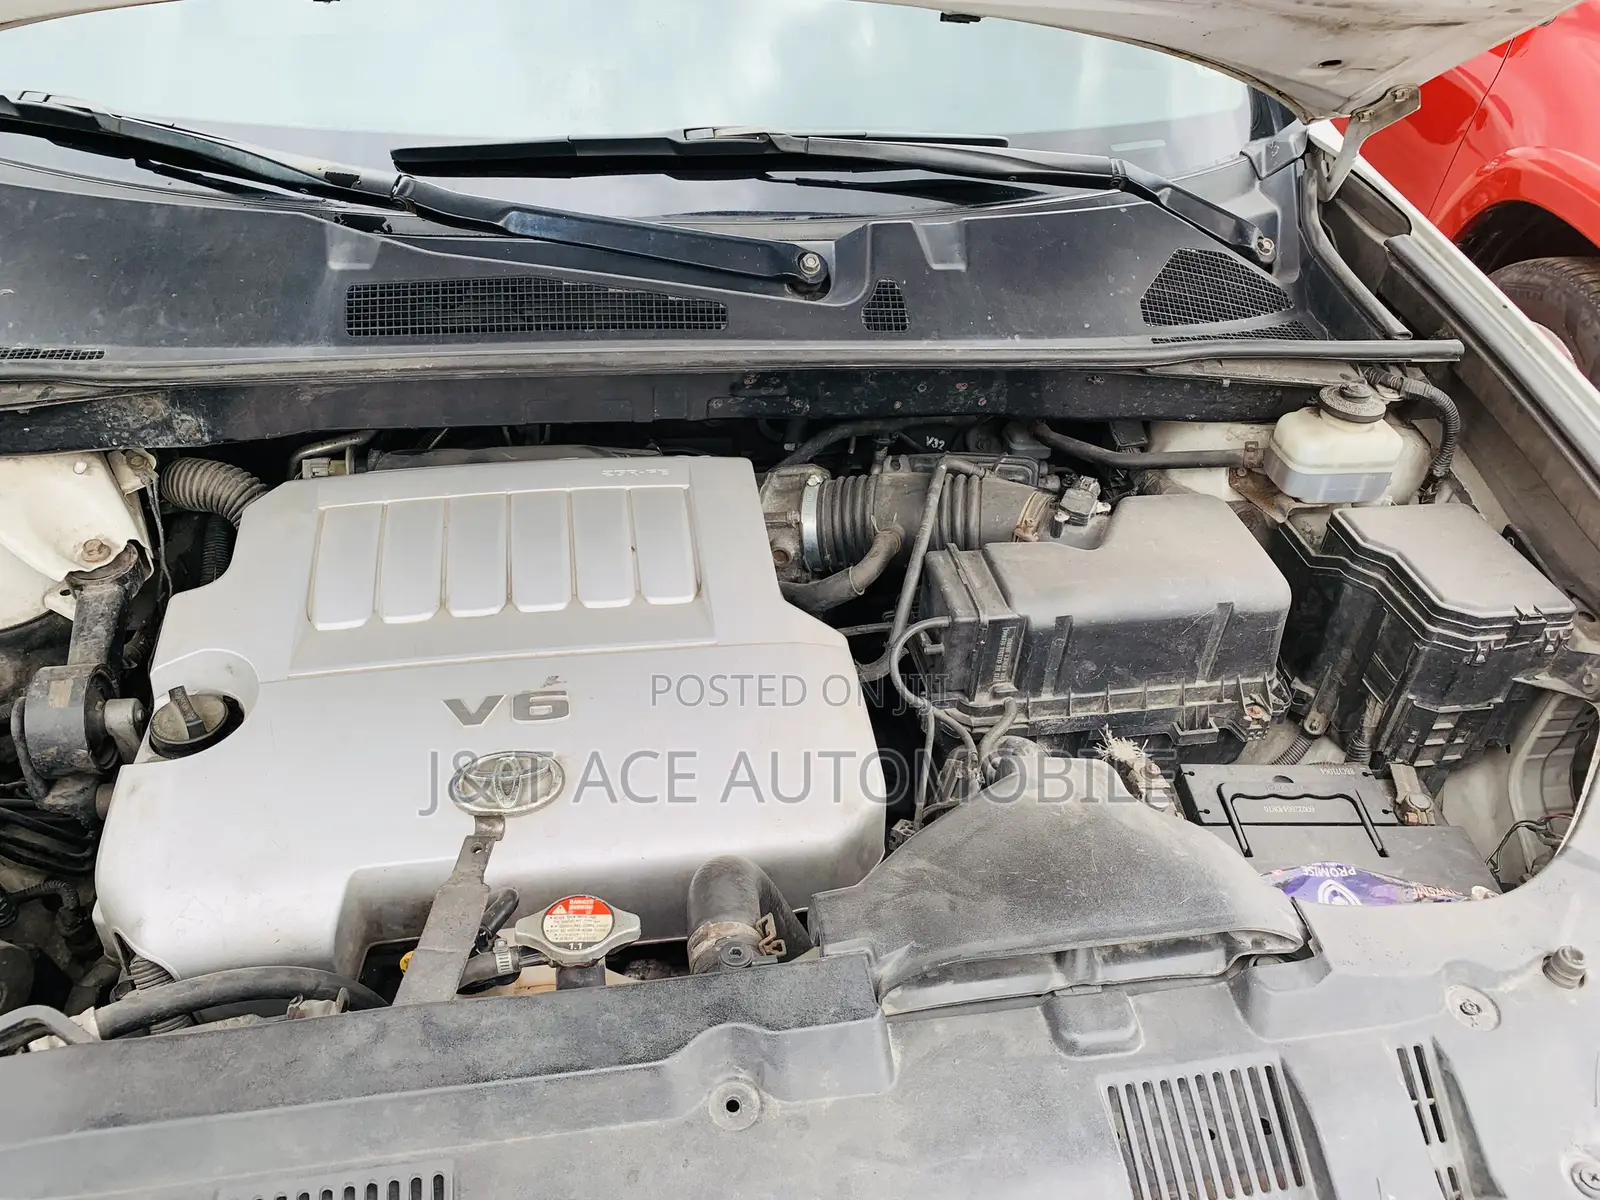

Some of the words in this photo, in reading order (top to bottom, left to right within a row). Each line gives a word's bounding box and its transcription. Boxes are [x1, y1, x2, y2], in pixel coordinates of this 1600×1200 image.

[926, 436, 945, 450] V32
[443, 690, 570, 726] V6
[1302, 865, 1357, 877] PROMISE
[568, 942, 583, 950] 1.1
